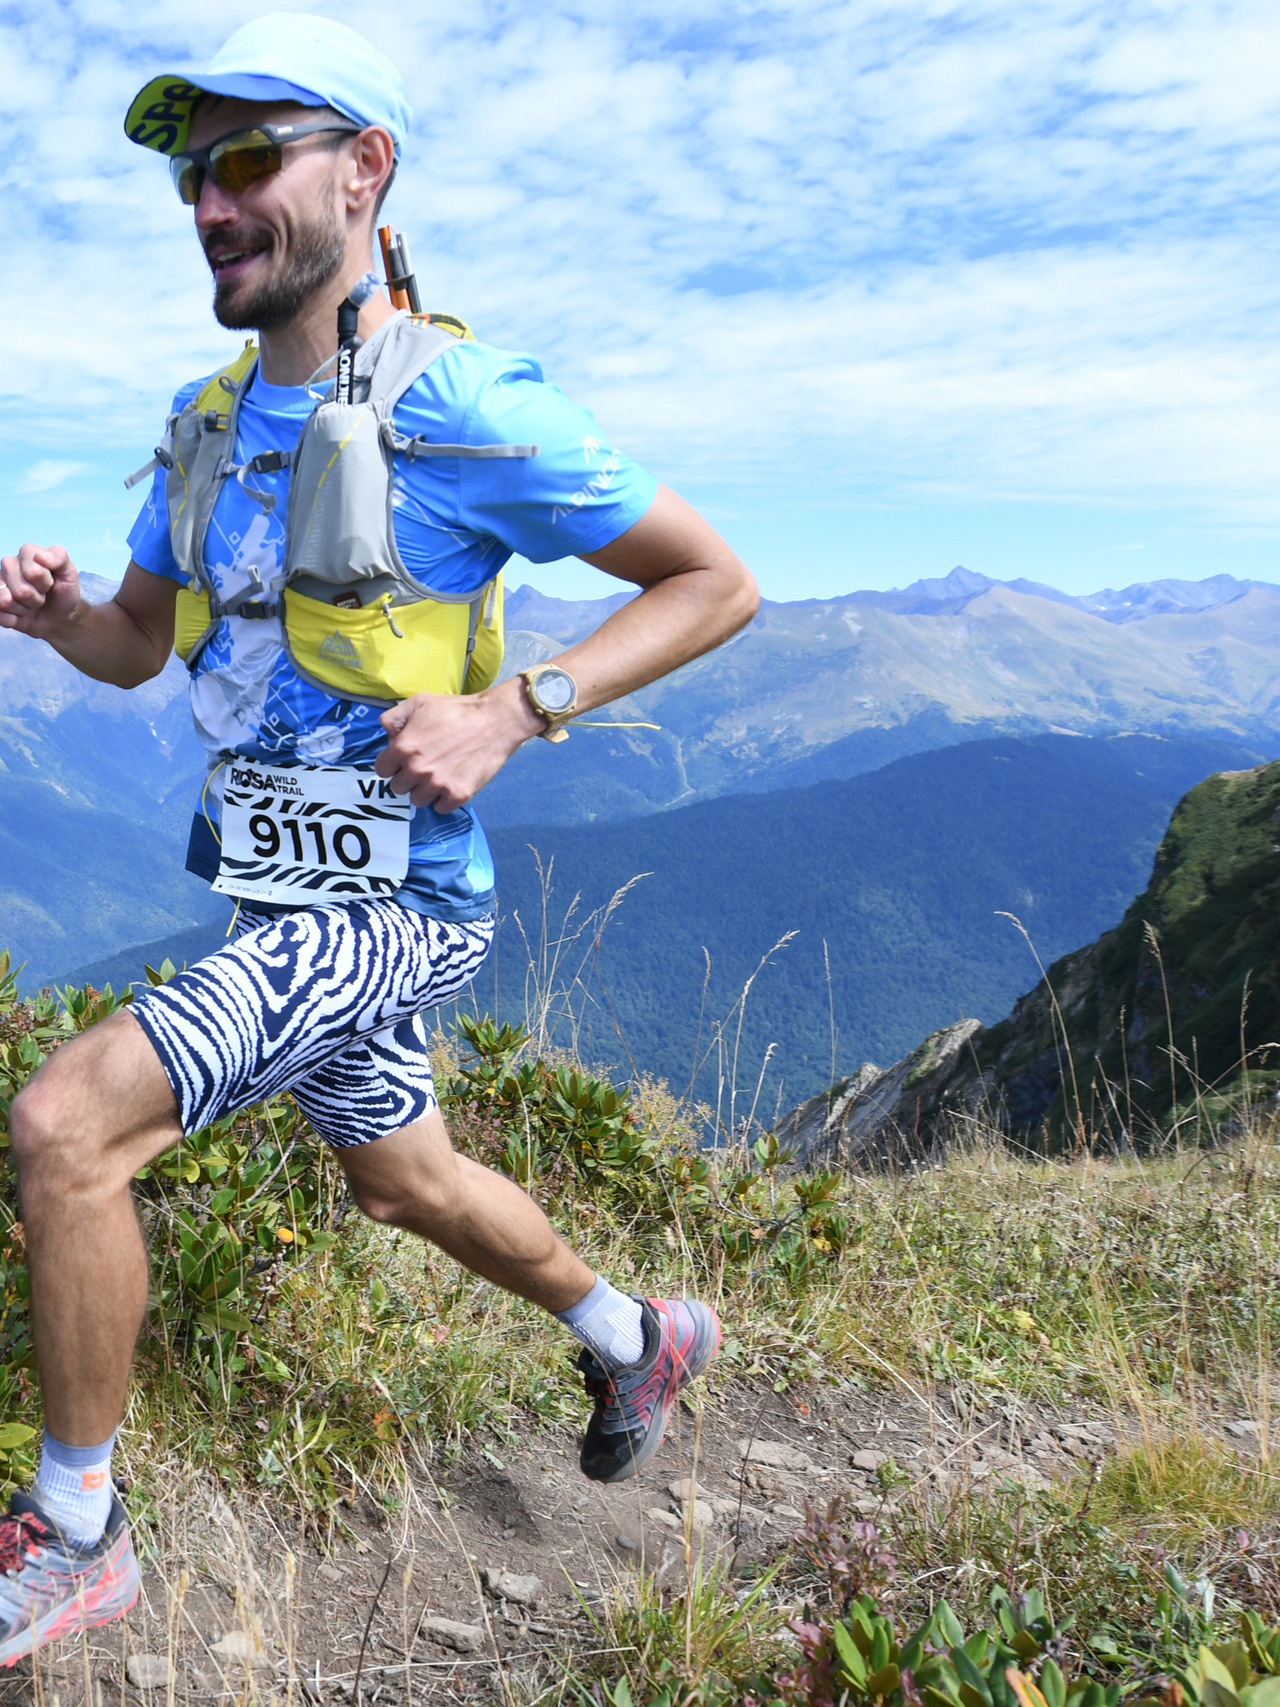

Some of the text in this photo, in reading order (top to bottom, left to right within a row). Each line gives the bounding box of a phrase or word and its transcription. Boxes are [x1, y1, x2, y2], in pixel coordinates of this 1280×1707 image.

[230, 767, 298, 792] ROSA WILD
[277, 785, 305, 796] TRAIL
[357, 779, 397, 799] VK
[249, 814, 371, 870] 9110
